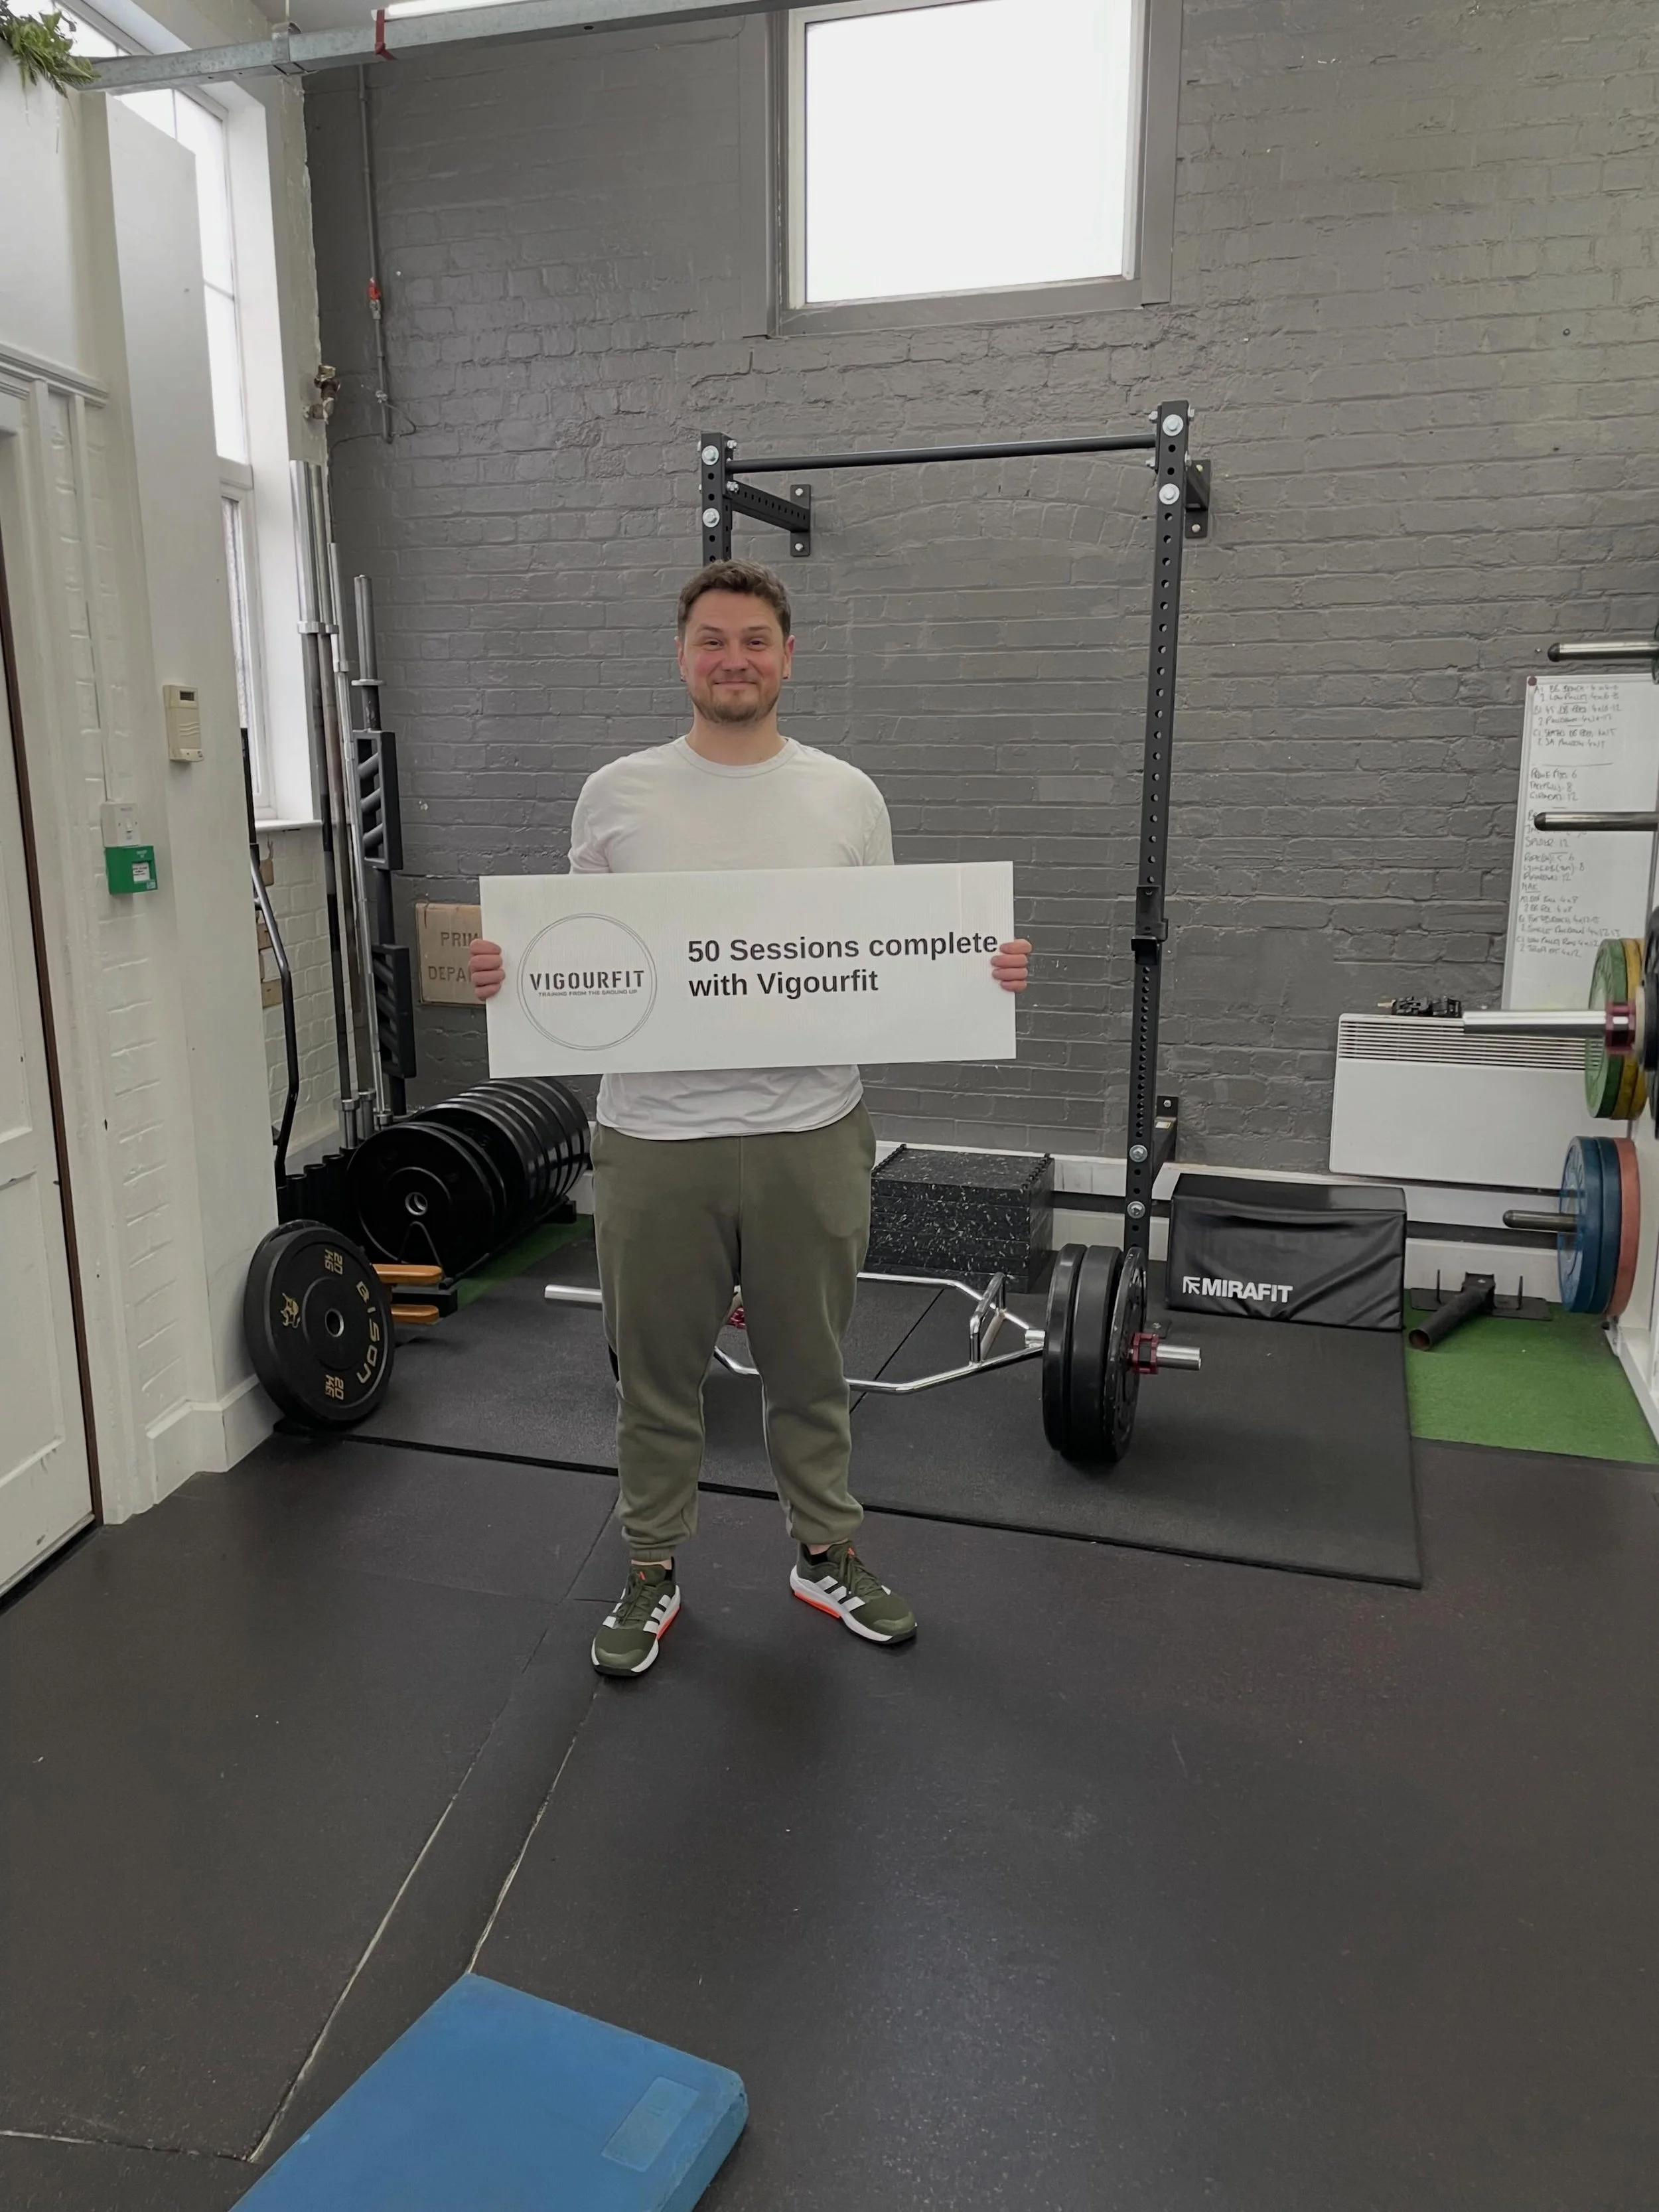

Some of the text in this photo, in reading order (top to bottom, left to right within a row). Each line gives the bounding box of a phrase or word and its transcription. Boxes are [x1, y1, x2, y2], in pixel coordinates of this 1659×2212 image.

[687, 931, 998, 962] 50 Sessions complete
[530, 970, 645, 991] VIGOURFIT
[688, 968, 879, 1000] with Vigourfit
[324, 1248, 334, 1274] KG
[334, 1252, 344, 1276] 20
[1201, 1278, 1293, 1303] MIRAFIT
[325, 1374, 335, 1398] KG
[334, 1375, 344, 1401] 20
